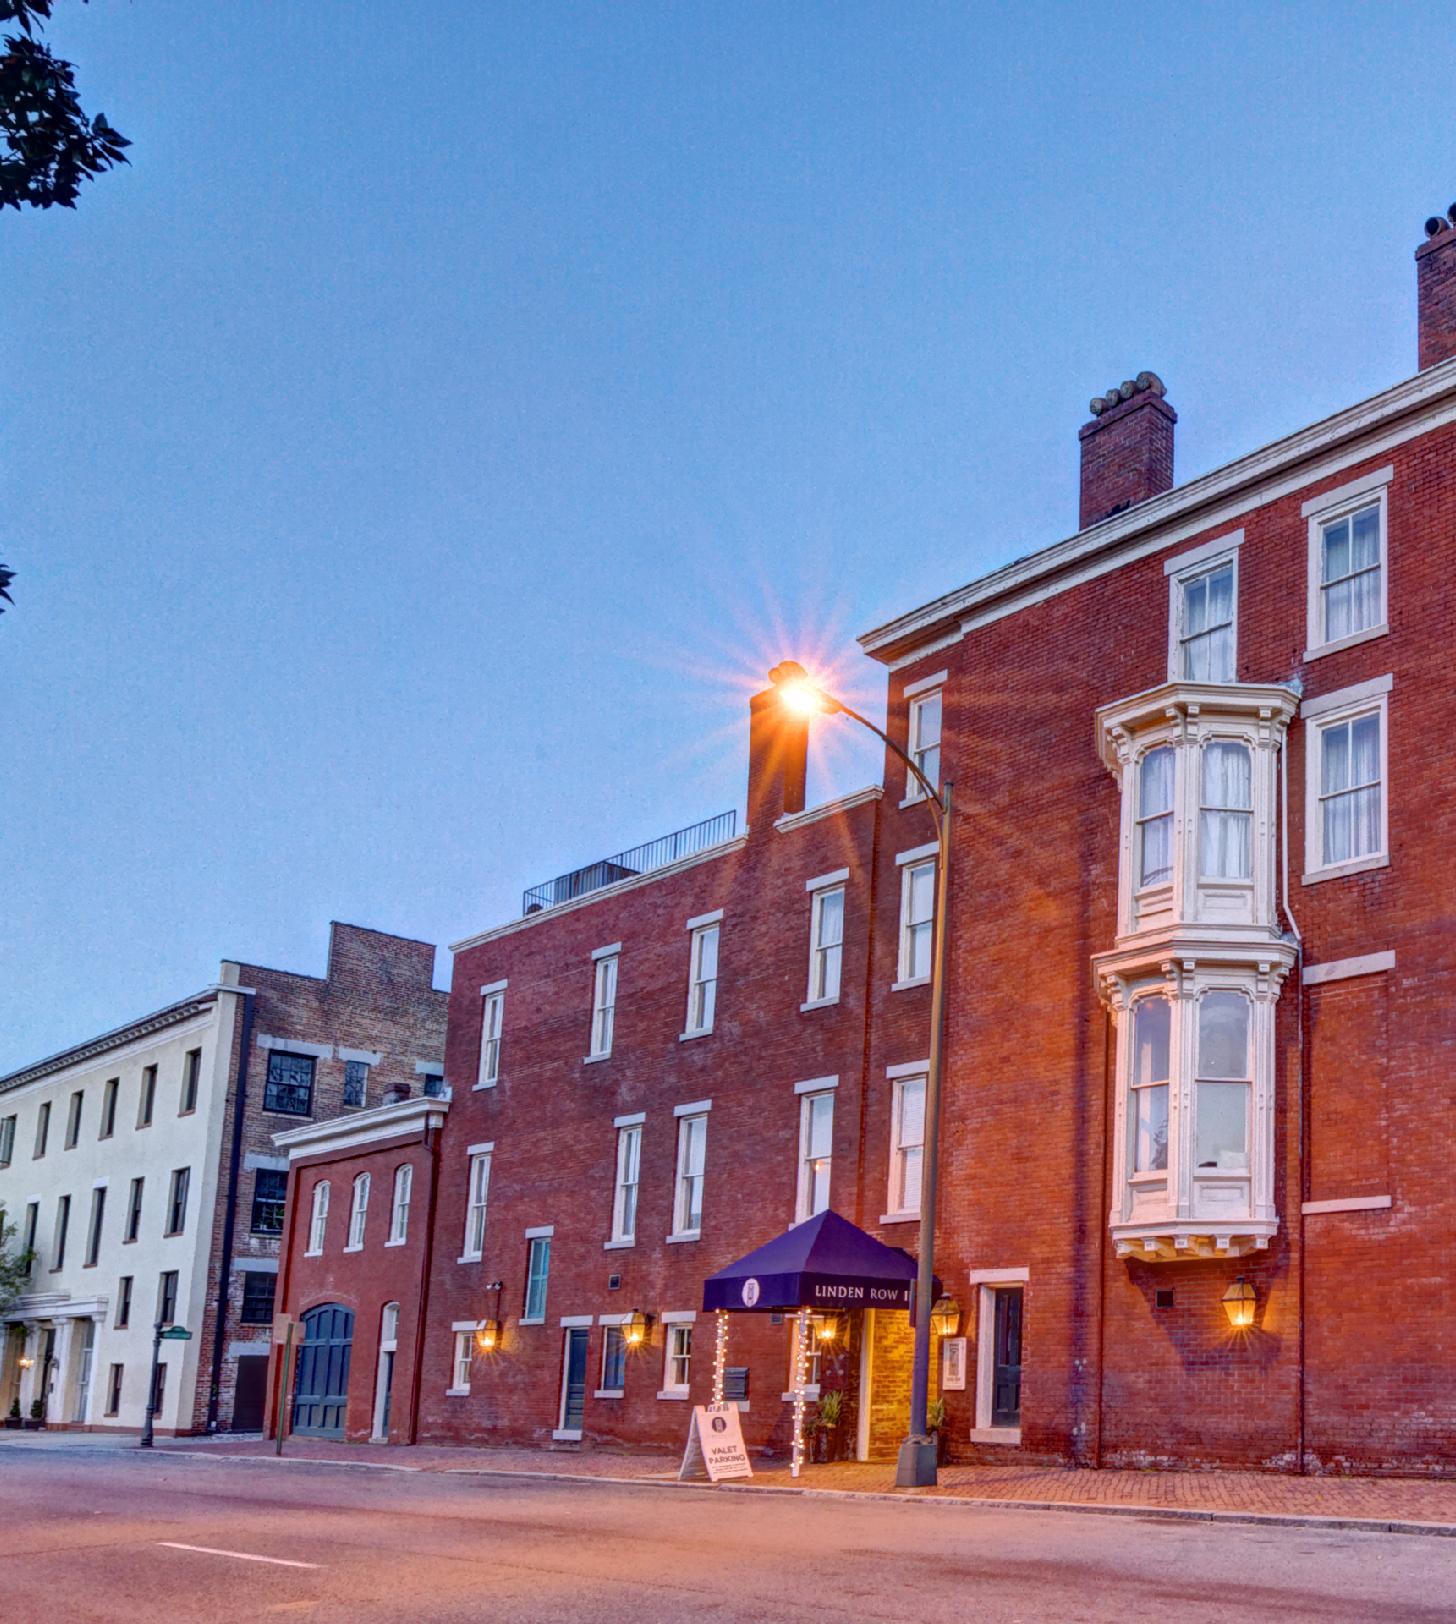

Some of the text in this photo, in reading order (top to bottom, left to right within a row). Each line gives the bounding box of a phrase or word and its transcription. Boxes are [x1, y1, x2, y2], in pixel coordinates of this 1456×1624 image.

[815, 1285, 864, 1298] LINDEN
[870, 1287, 899, 1300] ROW
[711, 1445, 737, 1455] VALET
[708, 1454, 746, 1464] PARKING
